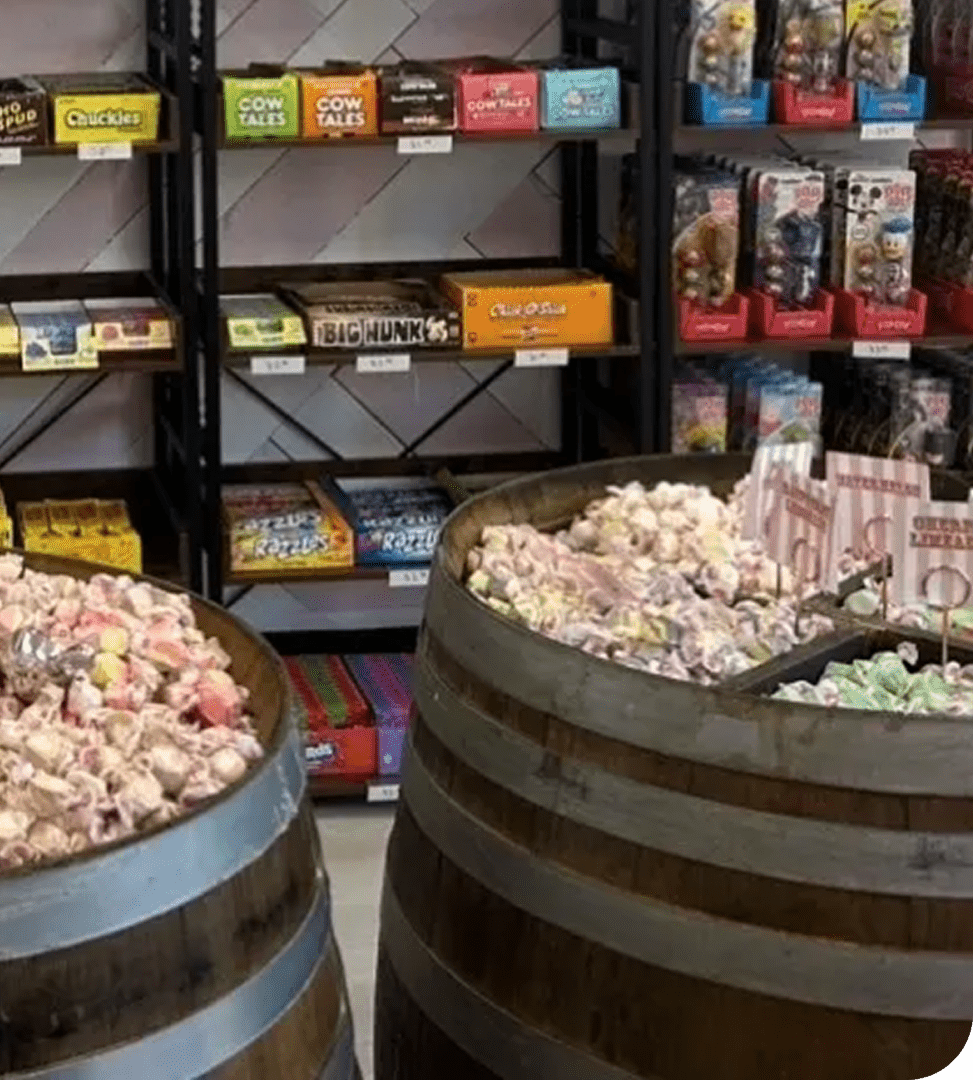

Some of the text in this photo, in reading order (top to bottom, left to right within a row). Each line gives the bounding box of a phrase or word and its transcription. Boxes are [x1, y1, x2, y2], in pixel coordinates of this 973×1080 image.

[239, 97, 283, 111] COW
[316, 96, 363, 111] COW
[239, 112, 286, 126] TALES
[316, 111, 366, 126] TALES
[321, 317, 424, 347] BIG HUNK
